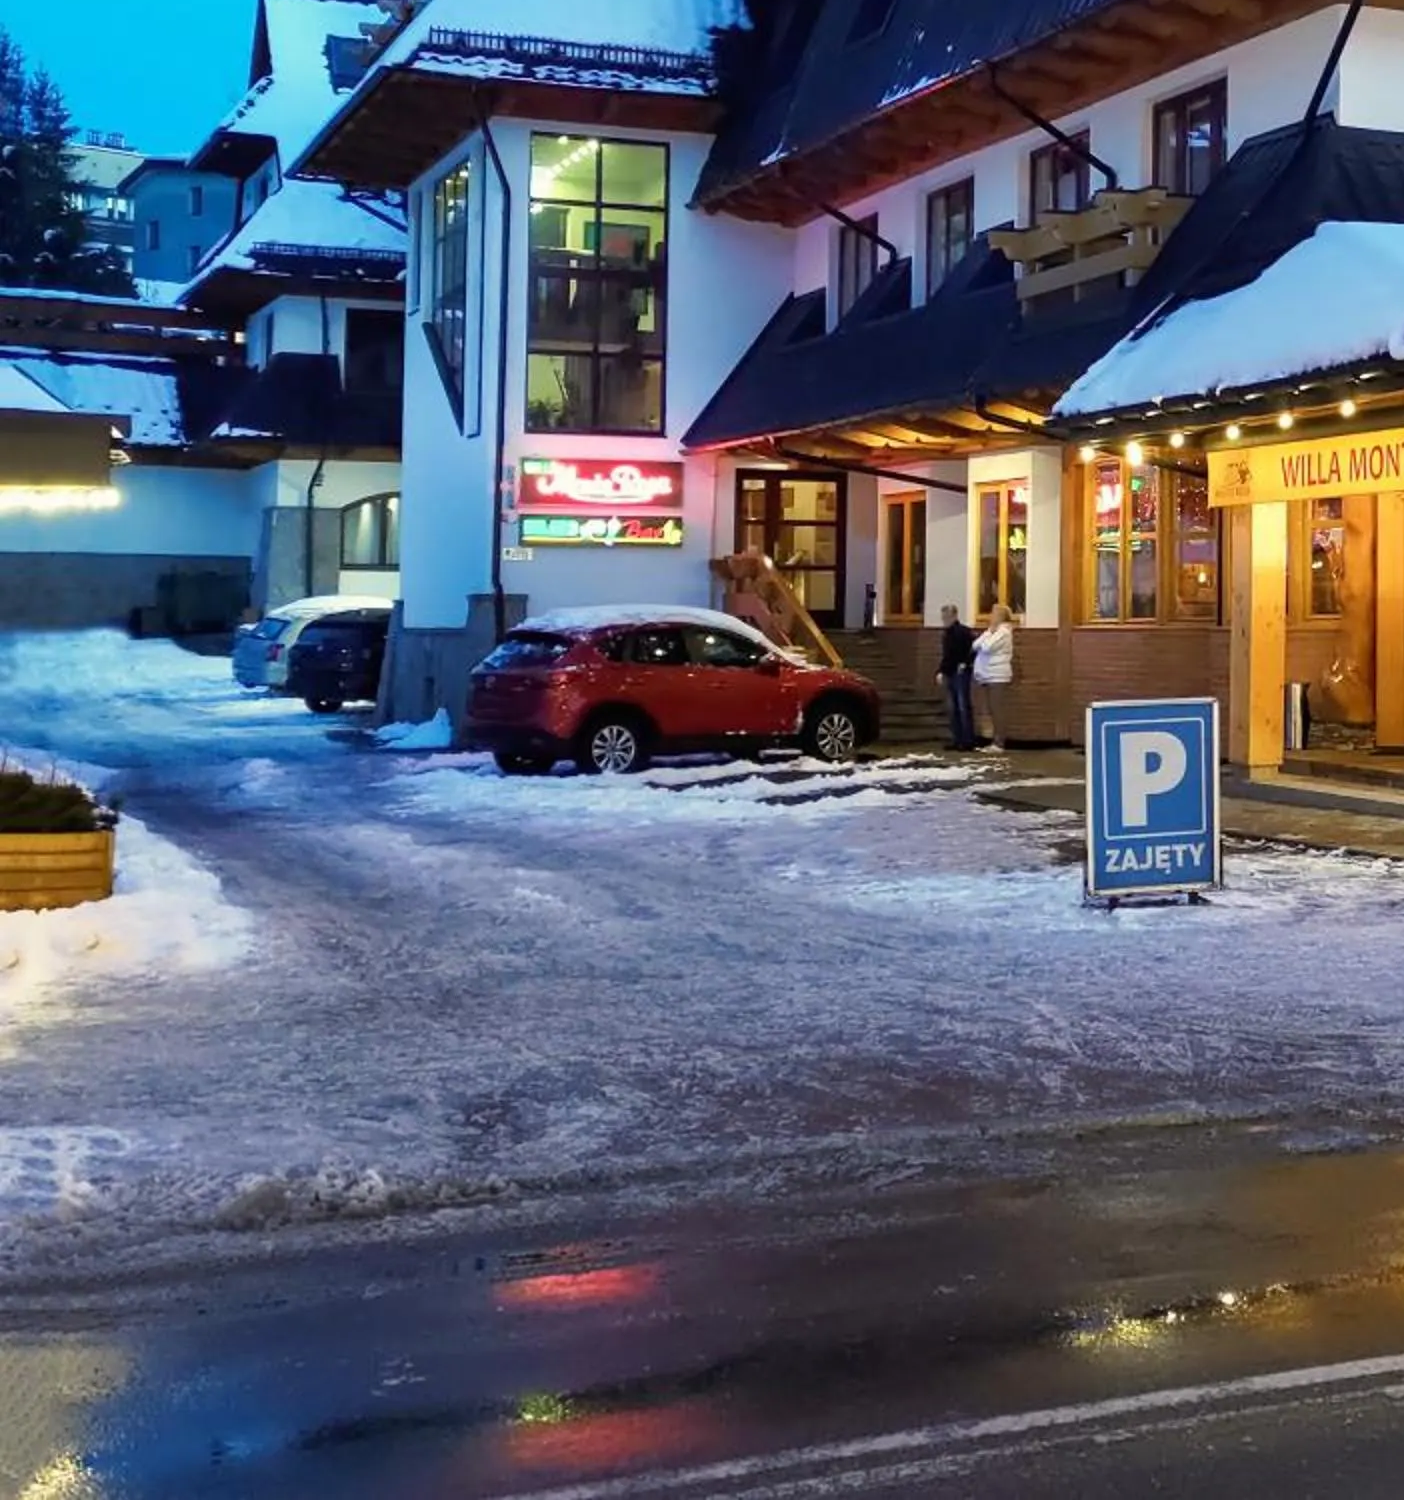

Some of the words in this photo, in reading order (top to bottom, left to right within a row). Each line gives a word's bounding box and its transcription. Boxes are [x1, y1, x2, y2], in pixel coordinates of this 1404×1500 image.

[1281, 451, 1342, 488] WILLA
[1119, 731, 1188, 827] P
[1105, 843, 1206, 875] ZAJĘTY
